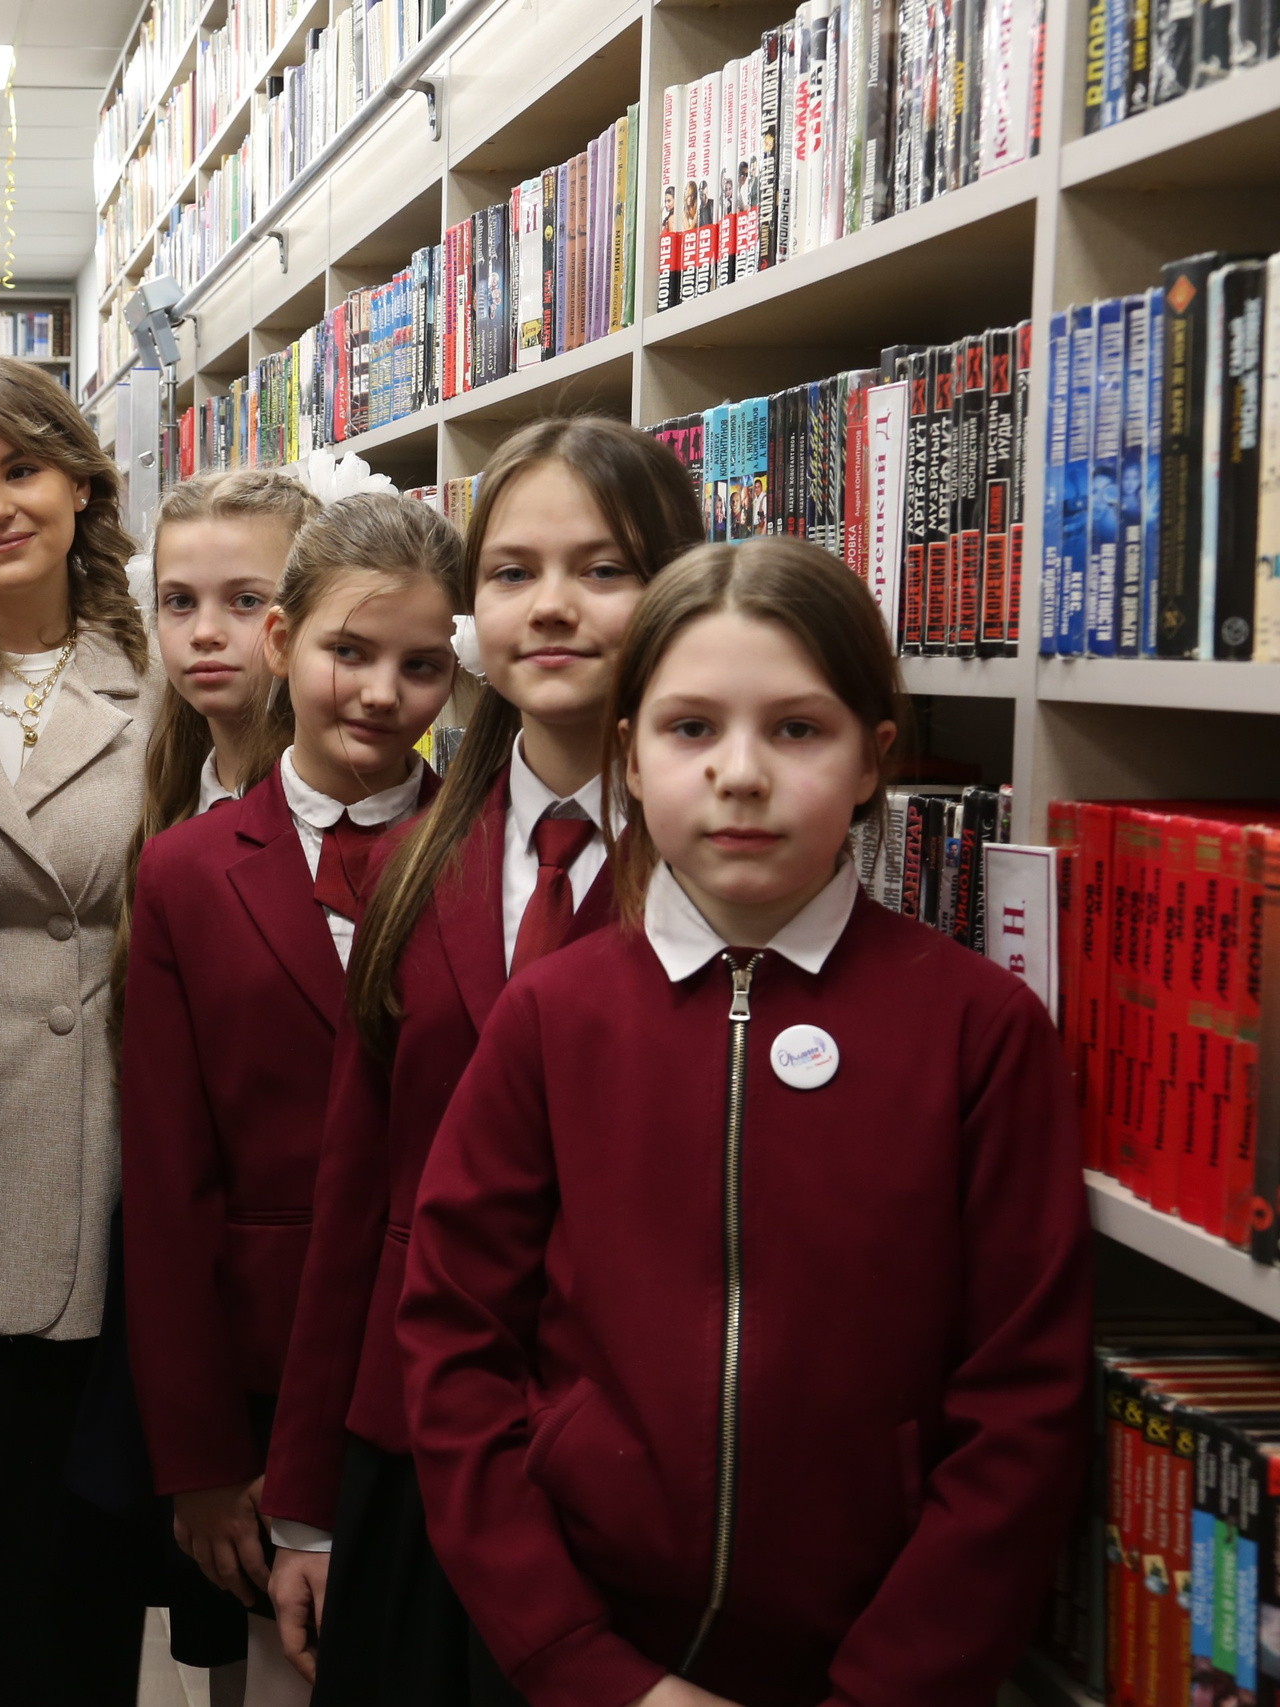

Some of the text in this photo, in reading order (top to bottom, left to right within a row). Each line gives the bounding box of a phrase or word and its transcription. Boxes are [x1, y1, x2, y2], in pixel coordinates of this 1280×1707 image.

[868, 12, 880, 88] Любовники
[686, 88, 698, 178] ДОЧЬ АВТОРИТЕТА
[761, 60, 778, 133] ЧЕЛОВЕК
[795, 80, 808, 161] ЖАЖДА
[809, 66, 823, 153] СЕКТА
[662, 93, 673, 185] БРАЧНЫЙ ПРИГОВОР
[780, 188, 790, 246] КОЛЫЧЕВ
[862, 199, 874, 230] Джон
[657, 236, 671, 308] КОЛЫЧЕВ
[681, 232, 697, 303] КОЛЫЧЕВ
[697, 229, 711, 296] КОЛЫЧЕВ
[338, 376, 346, 419] ДРУГАЯ
[987, 400, 999, 475] ПЕРСТЕНЬ
[997, 414, 1011, 459] ИУДЫ
[719, 419, 728, 476] КОНСТАНТИНОВ
[854, 430, 862, 489] КОНСТАНТИНОВ
[907, 428, 916, 531] МУЗЕЙНЫЙ
[915, 422, 926, 537] АРТЕФАКТ
[928, 422, 940, 530] МУЗЕЙНЫЙ
[939, 416, 952, 535] АРТЕФАКТ
[968, 417, 977, 499] ПОСЛЕДСТВИЯ
[874, 408, 892, 606] орецкий Д.
[927, 545, 948, 641] Д.КОРЕЦКИЙ
[959, 531, 979, 641] Д.КОРЕЦКИЙ
[984, 537, 1006, 640] Д.КОРЕЦКИЙ
[1043, 568, 1056, 638] НЕДОСТАТКОВ
[1096, 543, 1116, 641] НЕПРИЯТНОСТИ
[1124, 544, 1139, 583] СЛОВА
[1121, 596, 1138, 647] ДЕНЬГАХ
[903, 806, 922, 919] САНИТАР
[956, 829, 975, 936] ИСТОРИК
[1003, 899, 1026, 937] Н.
[1163, 906, 1174, 990] ЛЕОНОВ
[1191, 905, 1205, 990] ЛЕОНОВ
[1217, 914, 1230, 1001] ЛЕОНОВ
